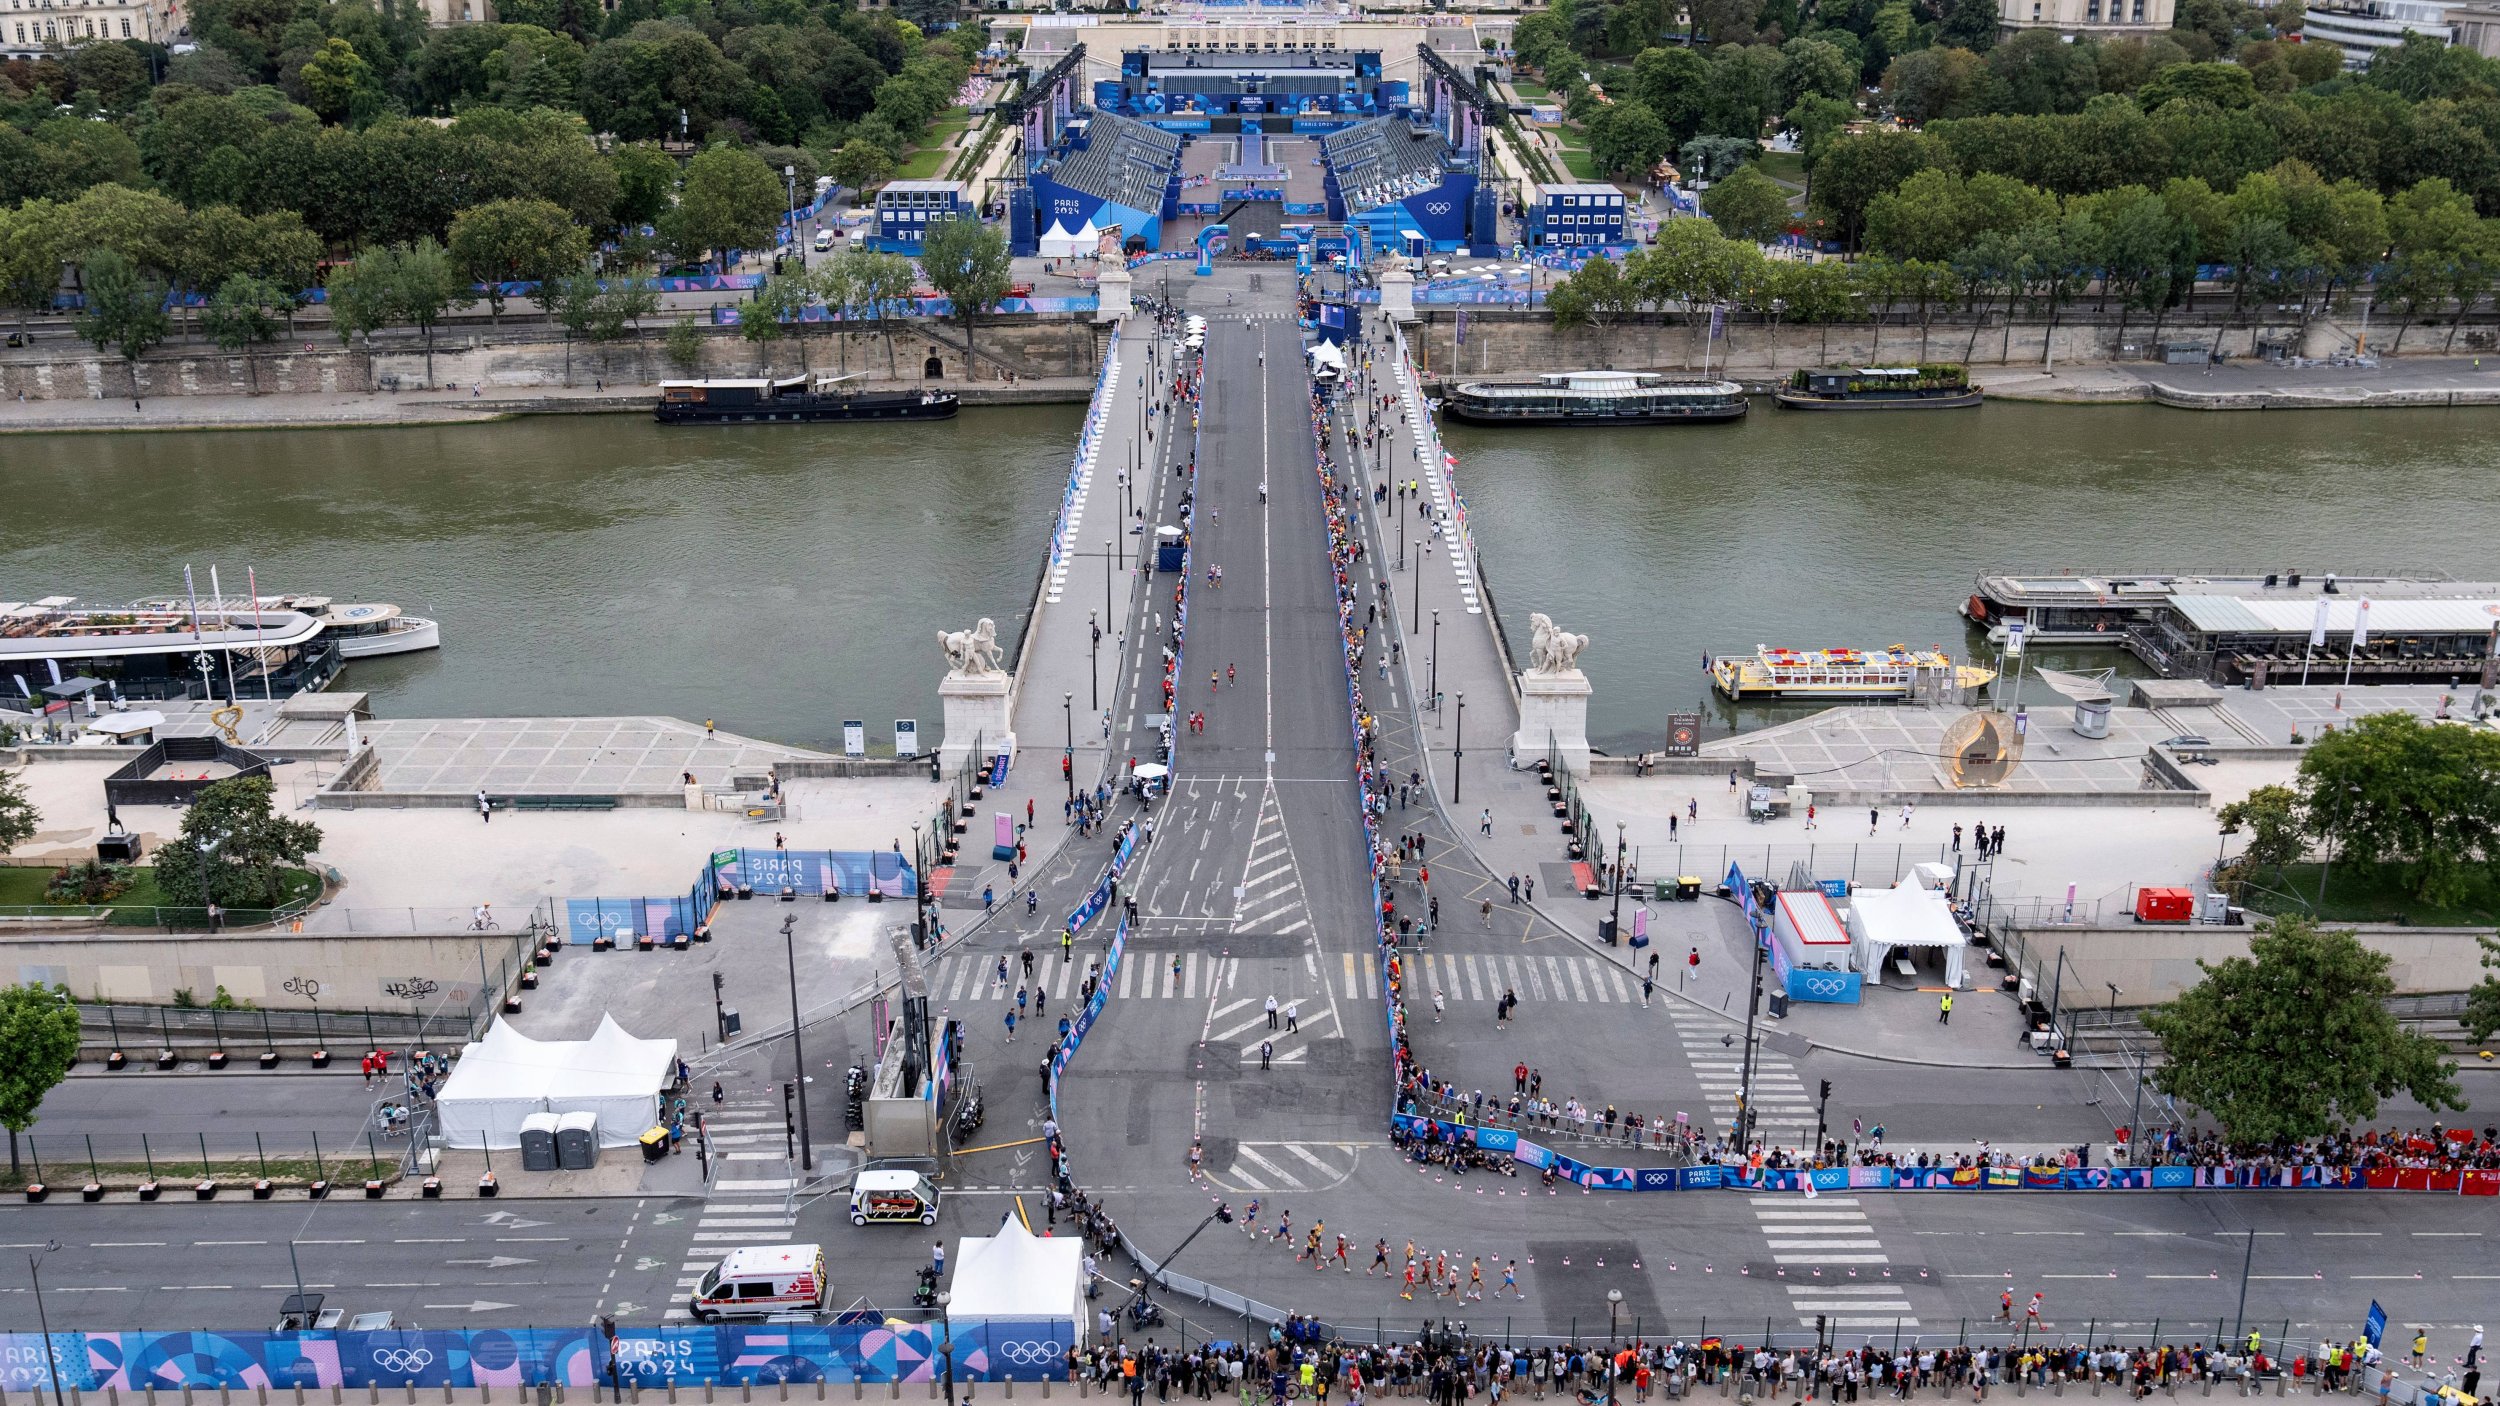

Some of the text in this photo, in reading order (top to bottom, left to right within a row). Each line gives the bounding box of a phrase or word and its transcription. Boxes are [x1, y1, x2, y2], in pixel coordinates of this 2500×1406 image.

[1388, 95, 1406, 103] PARIS
[1054, 199, 1080, 207] PARIS
[1054, 207, 1080, 215] 2024
[996, 756, 1007, 781] DÉPART
[1524, 1145, 1544, 1158] PARIS
[1523, 1151, 1543, 1164] 2024
[1689, 1169, 1711, 1177] PARIS
[1859, 1169, 1882, 1177] PARIS
[0, 1346, 63, 1363] ARIS
[620, 1359, 694, 1377] 2024
